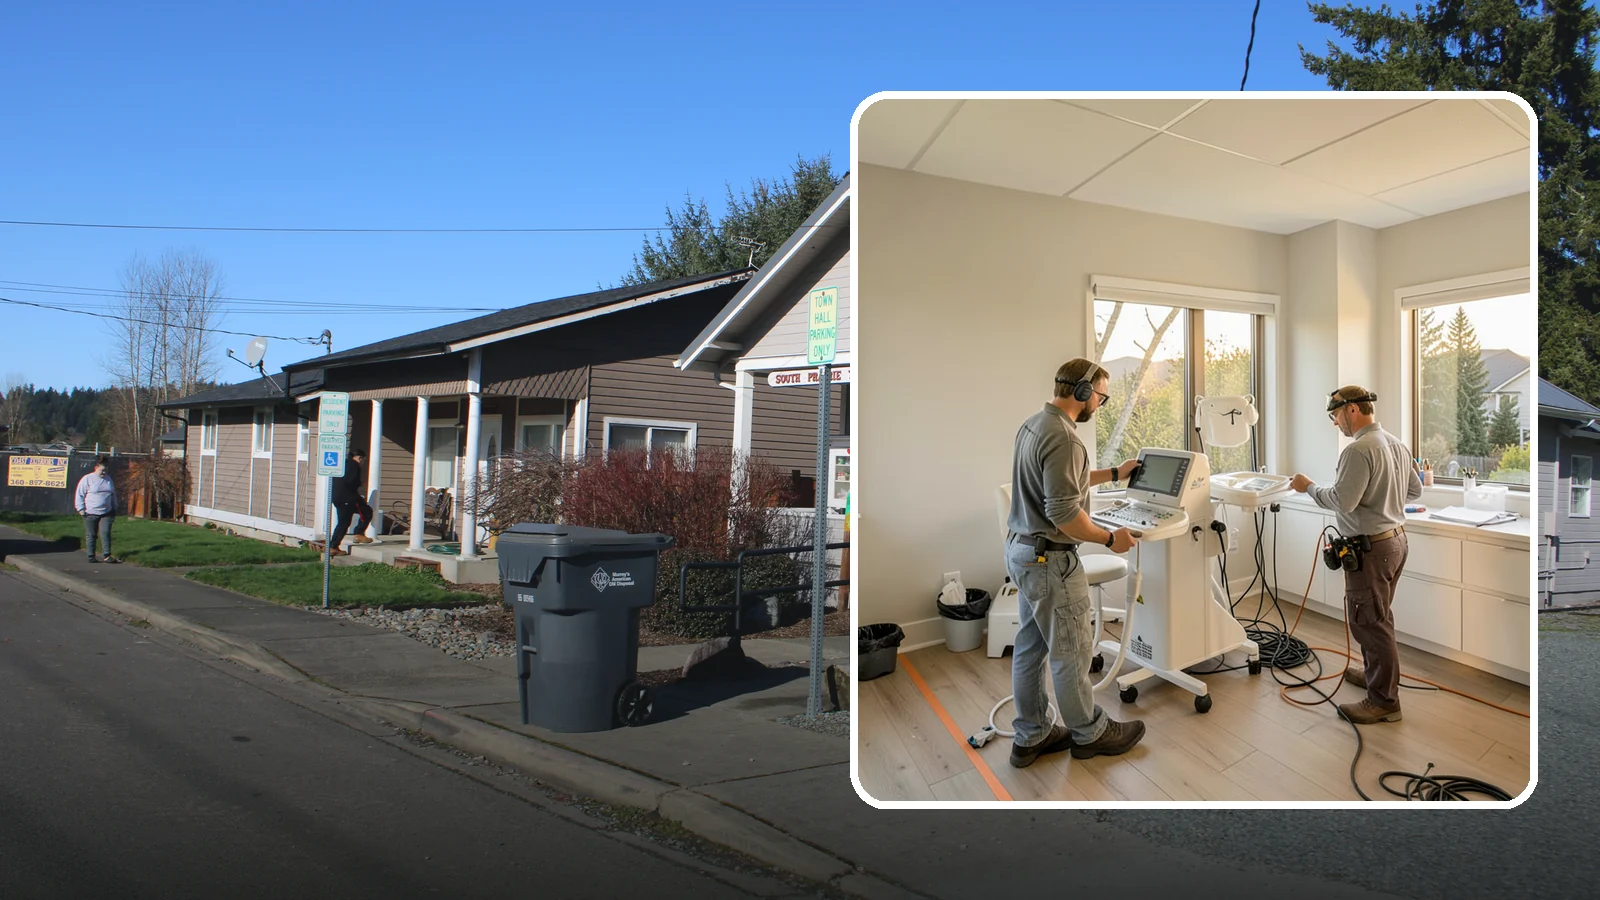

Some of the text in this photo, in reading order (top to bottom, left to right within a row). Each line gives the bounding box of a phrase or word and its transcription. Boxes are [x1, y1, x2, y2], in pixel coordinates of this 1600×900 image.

[815, 294, 833, 308] TOWN
[814, 311, 831, 324] HALL
[810, 327, 836, 340] PARKING
[813, 344, 831, 357] ONLY
[776, 374, 801, 384] SOUTH
